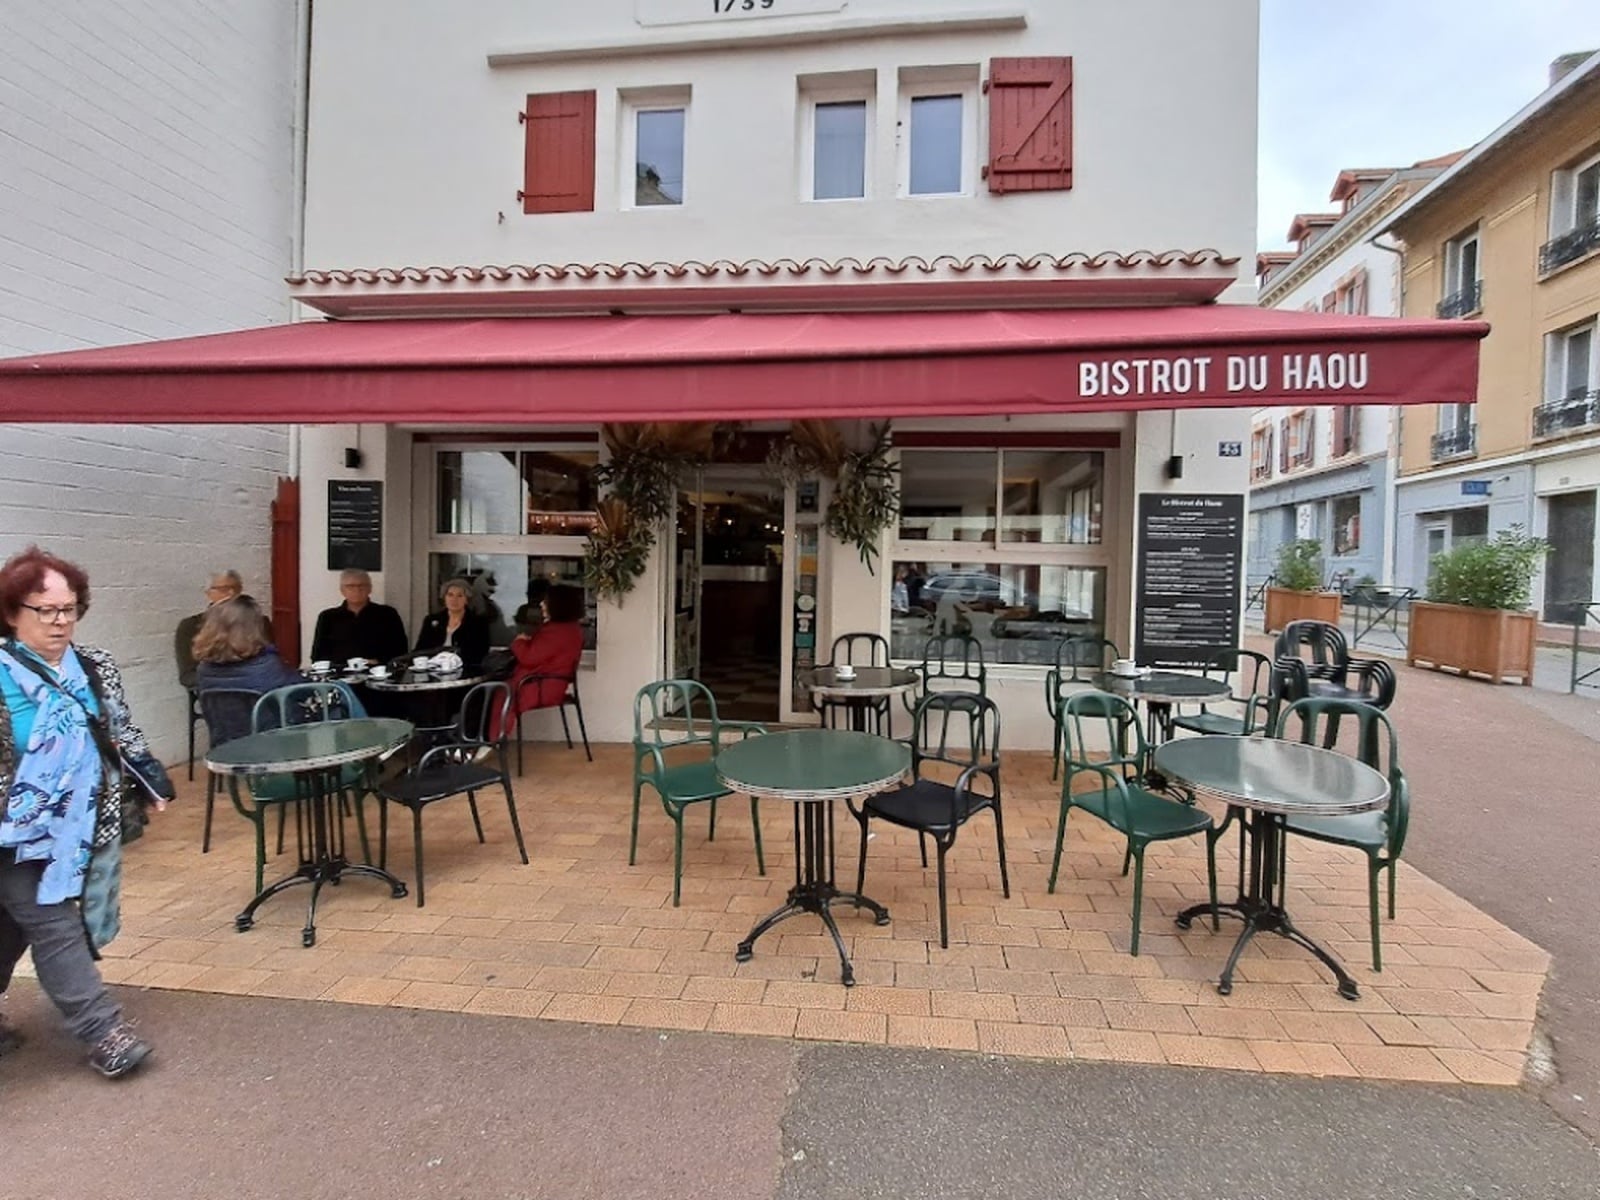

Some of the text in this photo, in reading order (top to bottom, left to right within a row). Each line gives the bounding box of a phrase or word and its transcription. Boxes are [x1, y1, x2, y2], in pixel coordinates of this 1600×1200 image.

[1079, 353, 1369, 397] BISTROT DU HAOU
